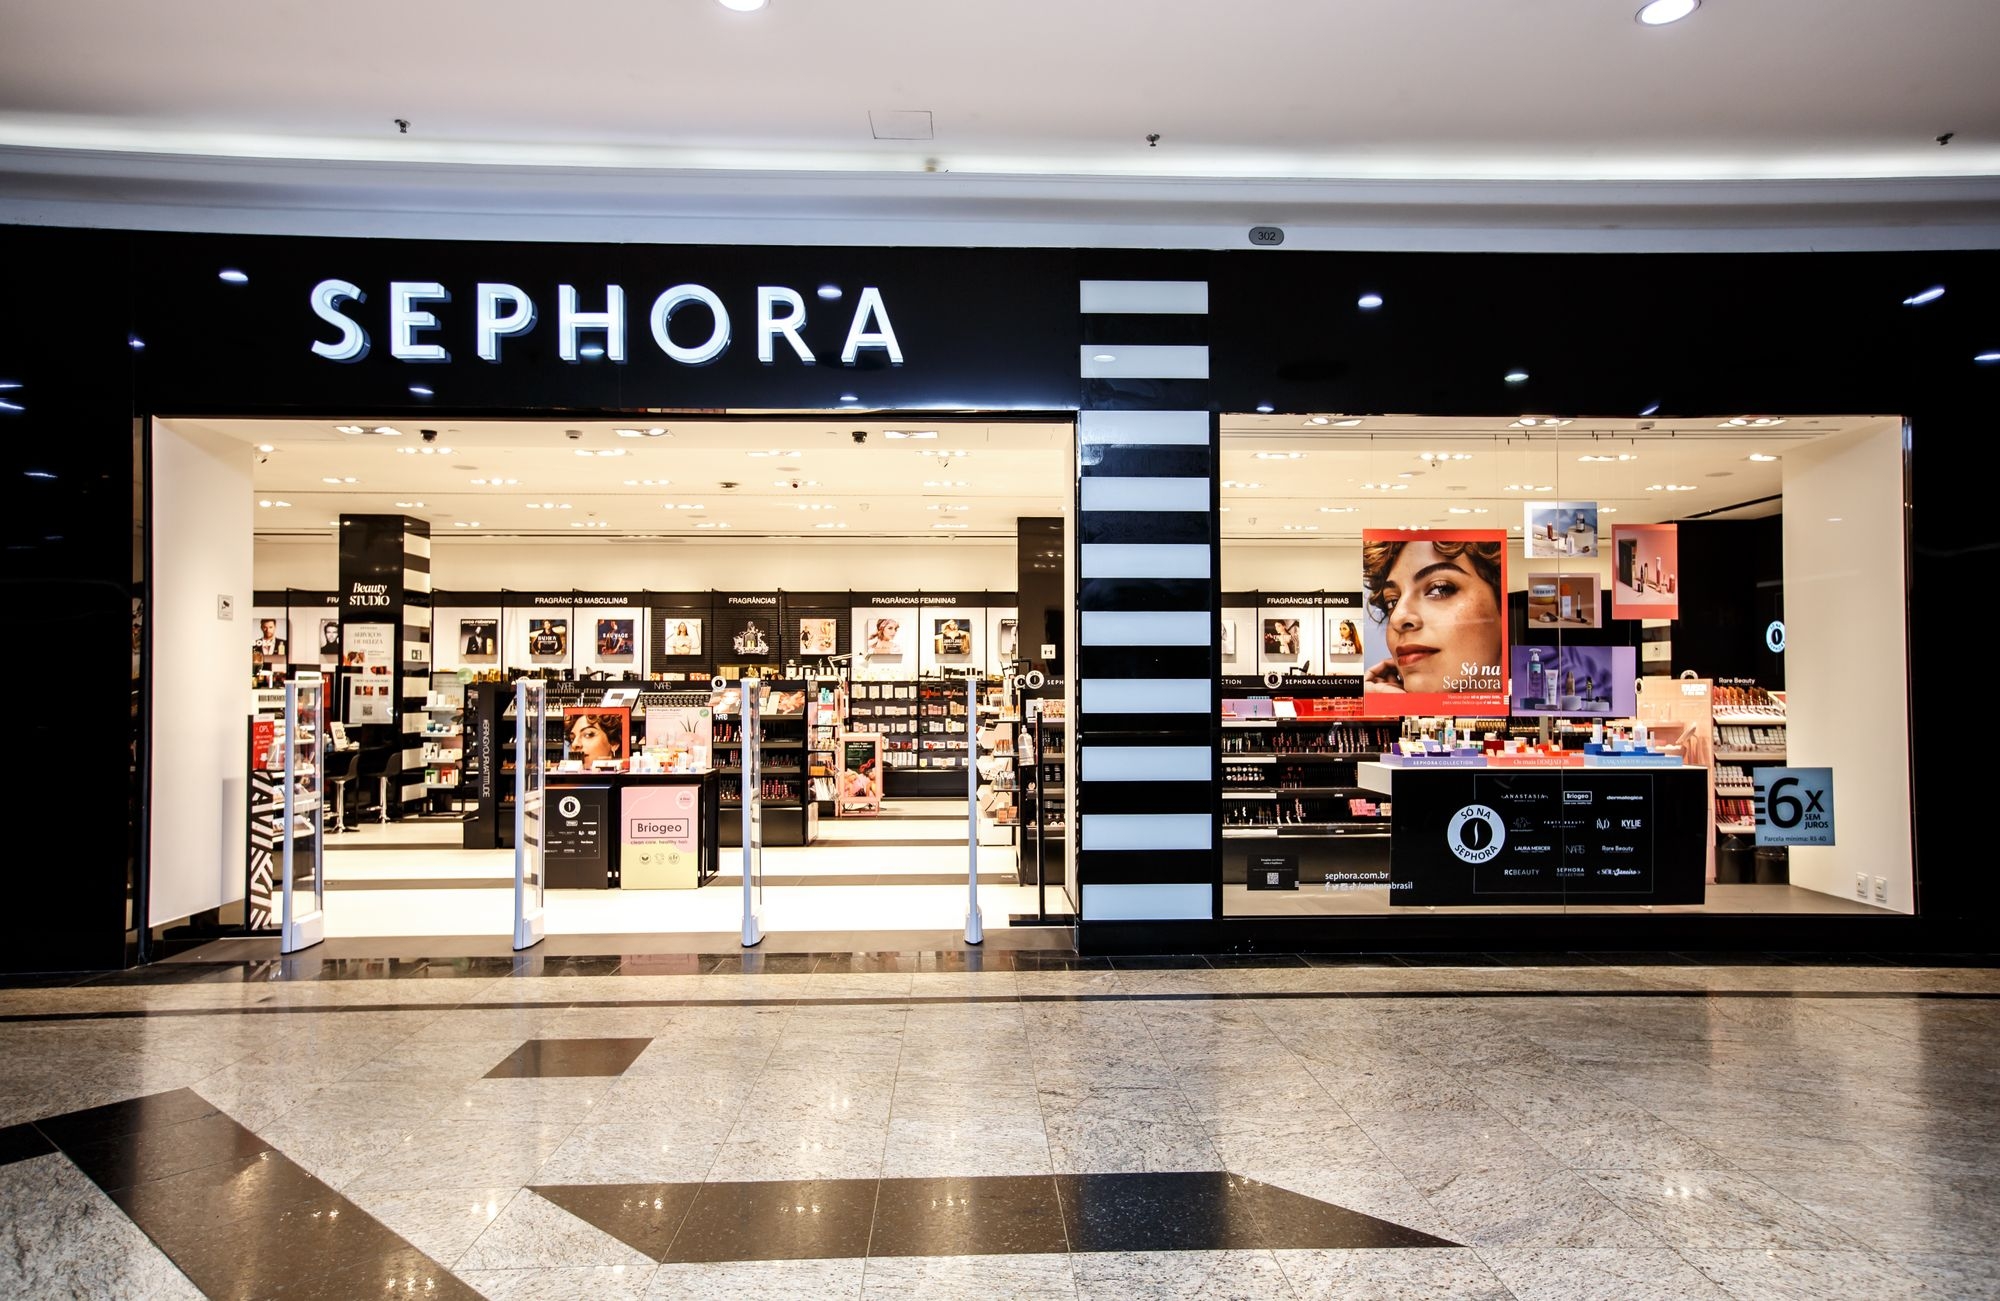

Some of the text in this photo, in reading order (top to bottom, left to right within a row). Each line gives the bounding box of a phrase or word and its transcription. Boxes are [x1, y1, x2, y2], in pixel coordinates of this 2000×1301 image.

[1258, 231, 1276, 241] 302
[310, 278, 905, 366] SEPHORA
[353, 582, 387, 595] Beauty
[349, 595, 391, 606] STUDIO
[728, 596, 777, 604] FRAGRÂNCIAS
[871, 596, 919, 604] FRAGRÂNCIAS
[1266, 596, 1313, 605] FRAGRÂNCIAS
[1460, 661, 1501, 676] Só na
[653, 681, 672, 690] NARS
[1442, 675, 1501, 692] Sephora
[1566, 792, 1589, 800] Briogeo
[1460, 806, 1491, 820] SÓ NA
[1804, 813, 1821, 821] SEM
[637, 822, 682, 835] Briogeo
[1621, 819, 1642, 828] KYLIE
[1804, 821, 1829, 830] JUROS
[1454, 844, 1498, 861] SEPHORA
[1615, 845, 1634, 853] Beauty
[1325, 871, 1390, 882] sephora.com.br
